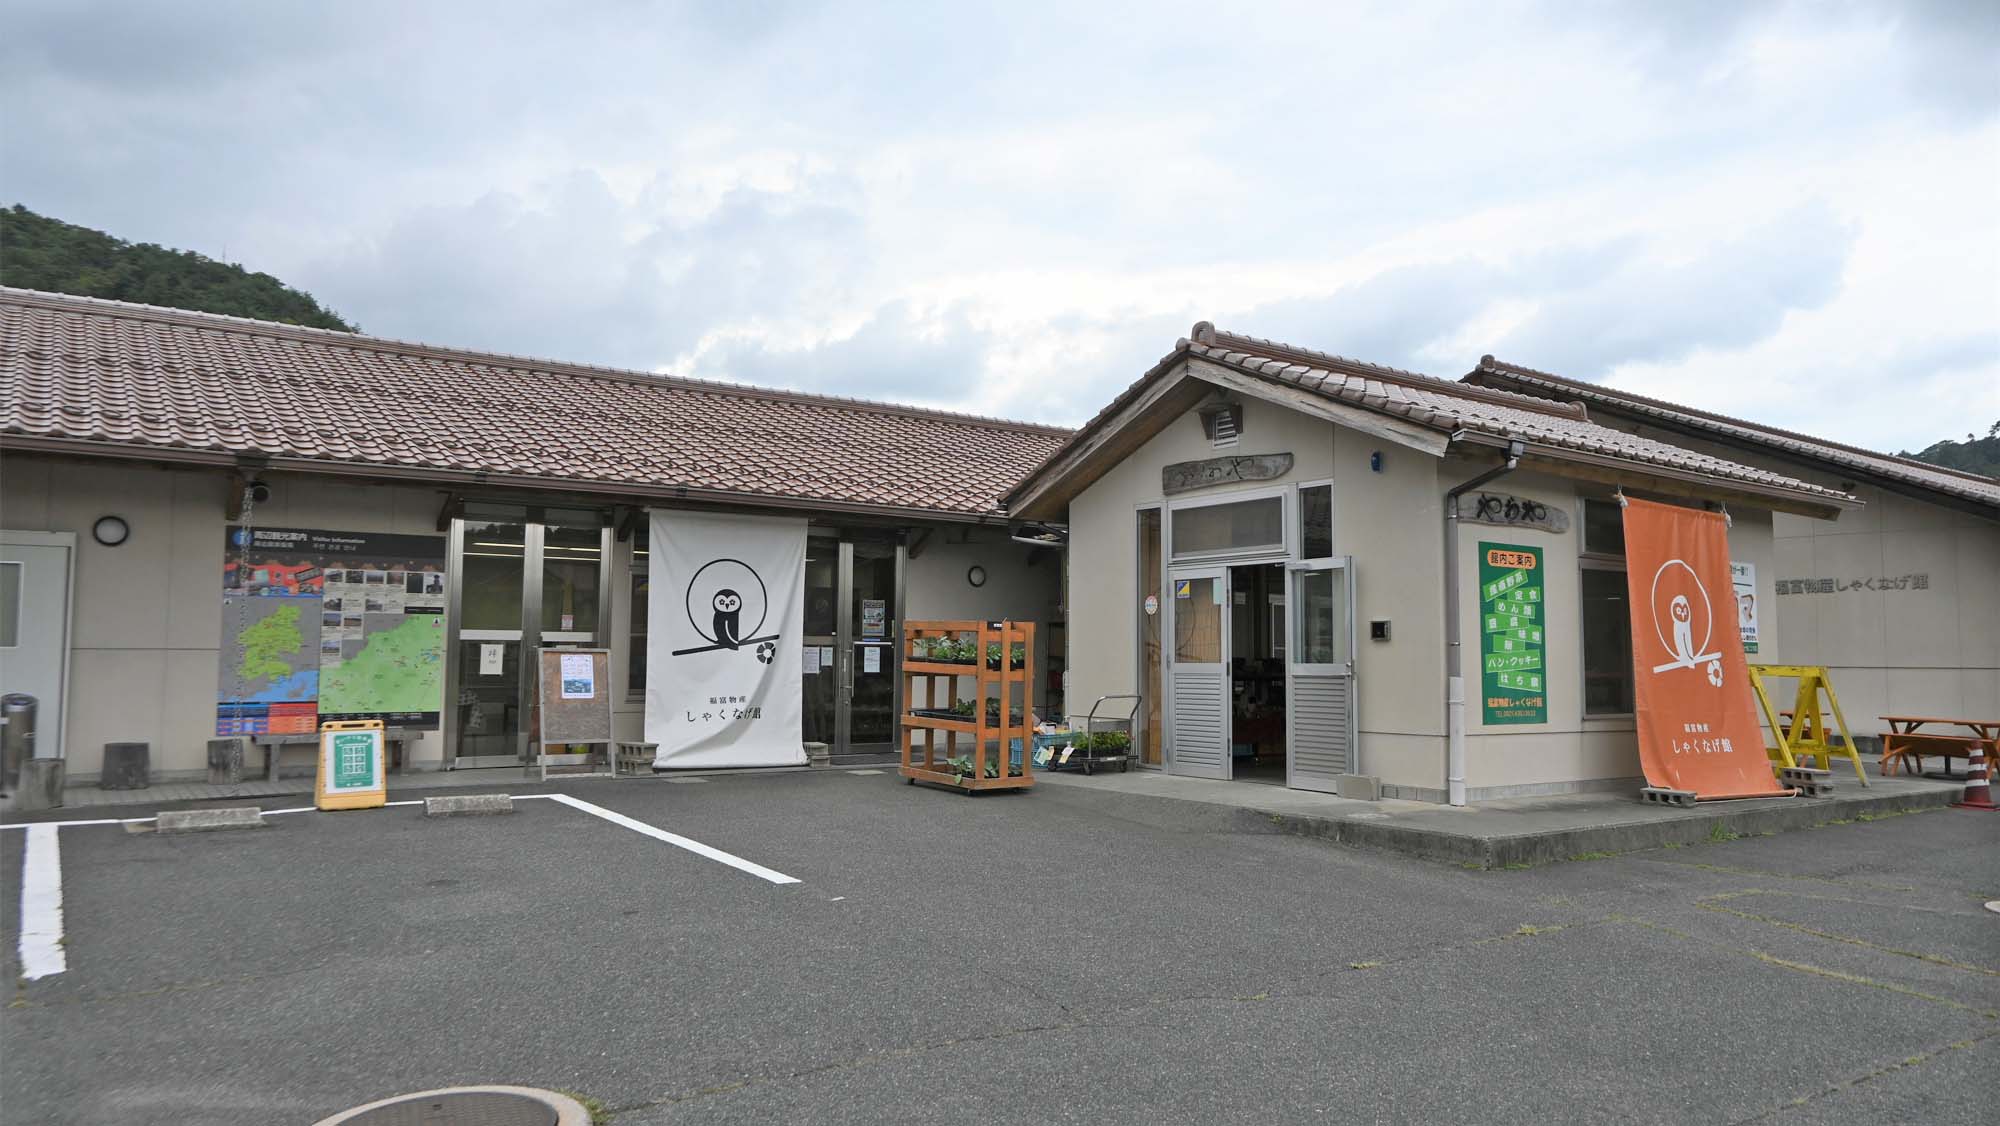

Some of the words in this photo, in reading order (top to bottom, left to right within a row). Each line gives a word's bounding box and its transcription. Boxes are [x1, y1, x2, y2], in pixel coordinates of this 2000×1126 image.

[1491, 551, 1533, 567] 館内ご案内
[1775, 574, 1929, 595] 福富物産しゃくなげ館
[1488, 655, 1538, 668] パン・クッキー
[709, 695, 746, 704] 福富物産
[687, 707, 761, 722] しゃくなげ館
[1672, 738, 1733, 754] しゃくなげ館
